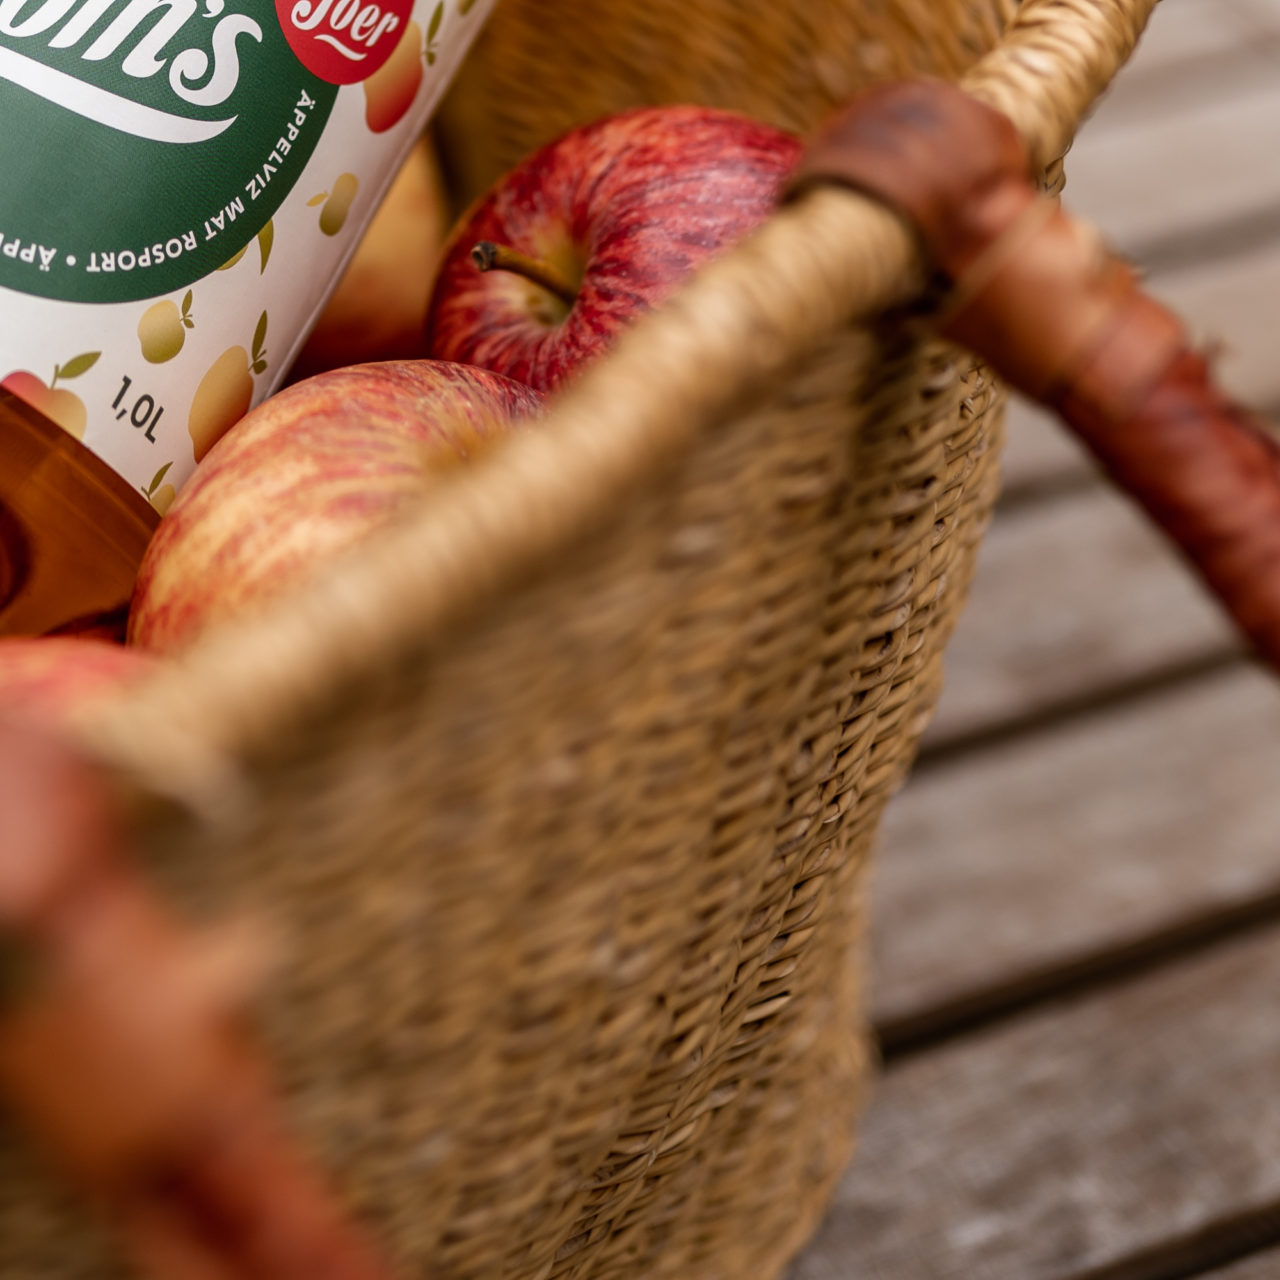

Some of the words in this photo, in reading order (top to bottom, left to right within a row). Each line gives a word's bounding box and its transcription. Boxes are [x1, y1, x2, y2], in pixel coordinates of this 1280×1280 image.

[245, 89, 317, 202] ÄPPELVIZ
[205, 198, 246, 241] MAT
[86, 230, 198, 273] ROSPORT
[111, 373, 165, 445] 1,0L
